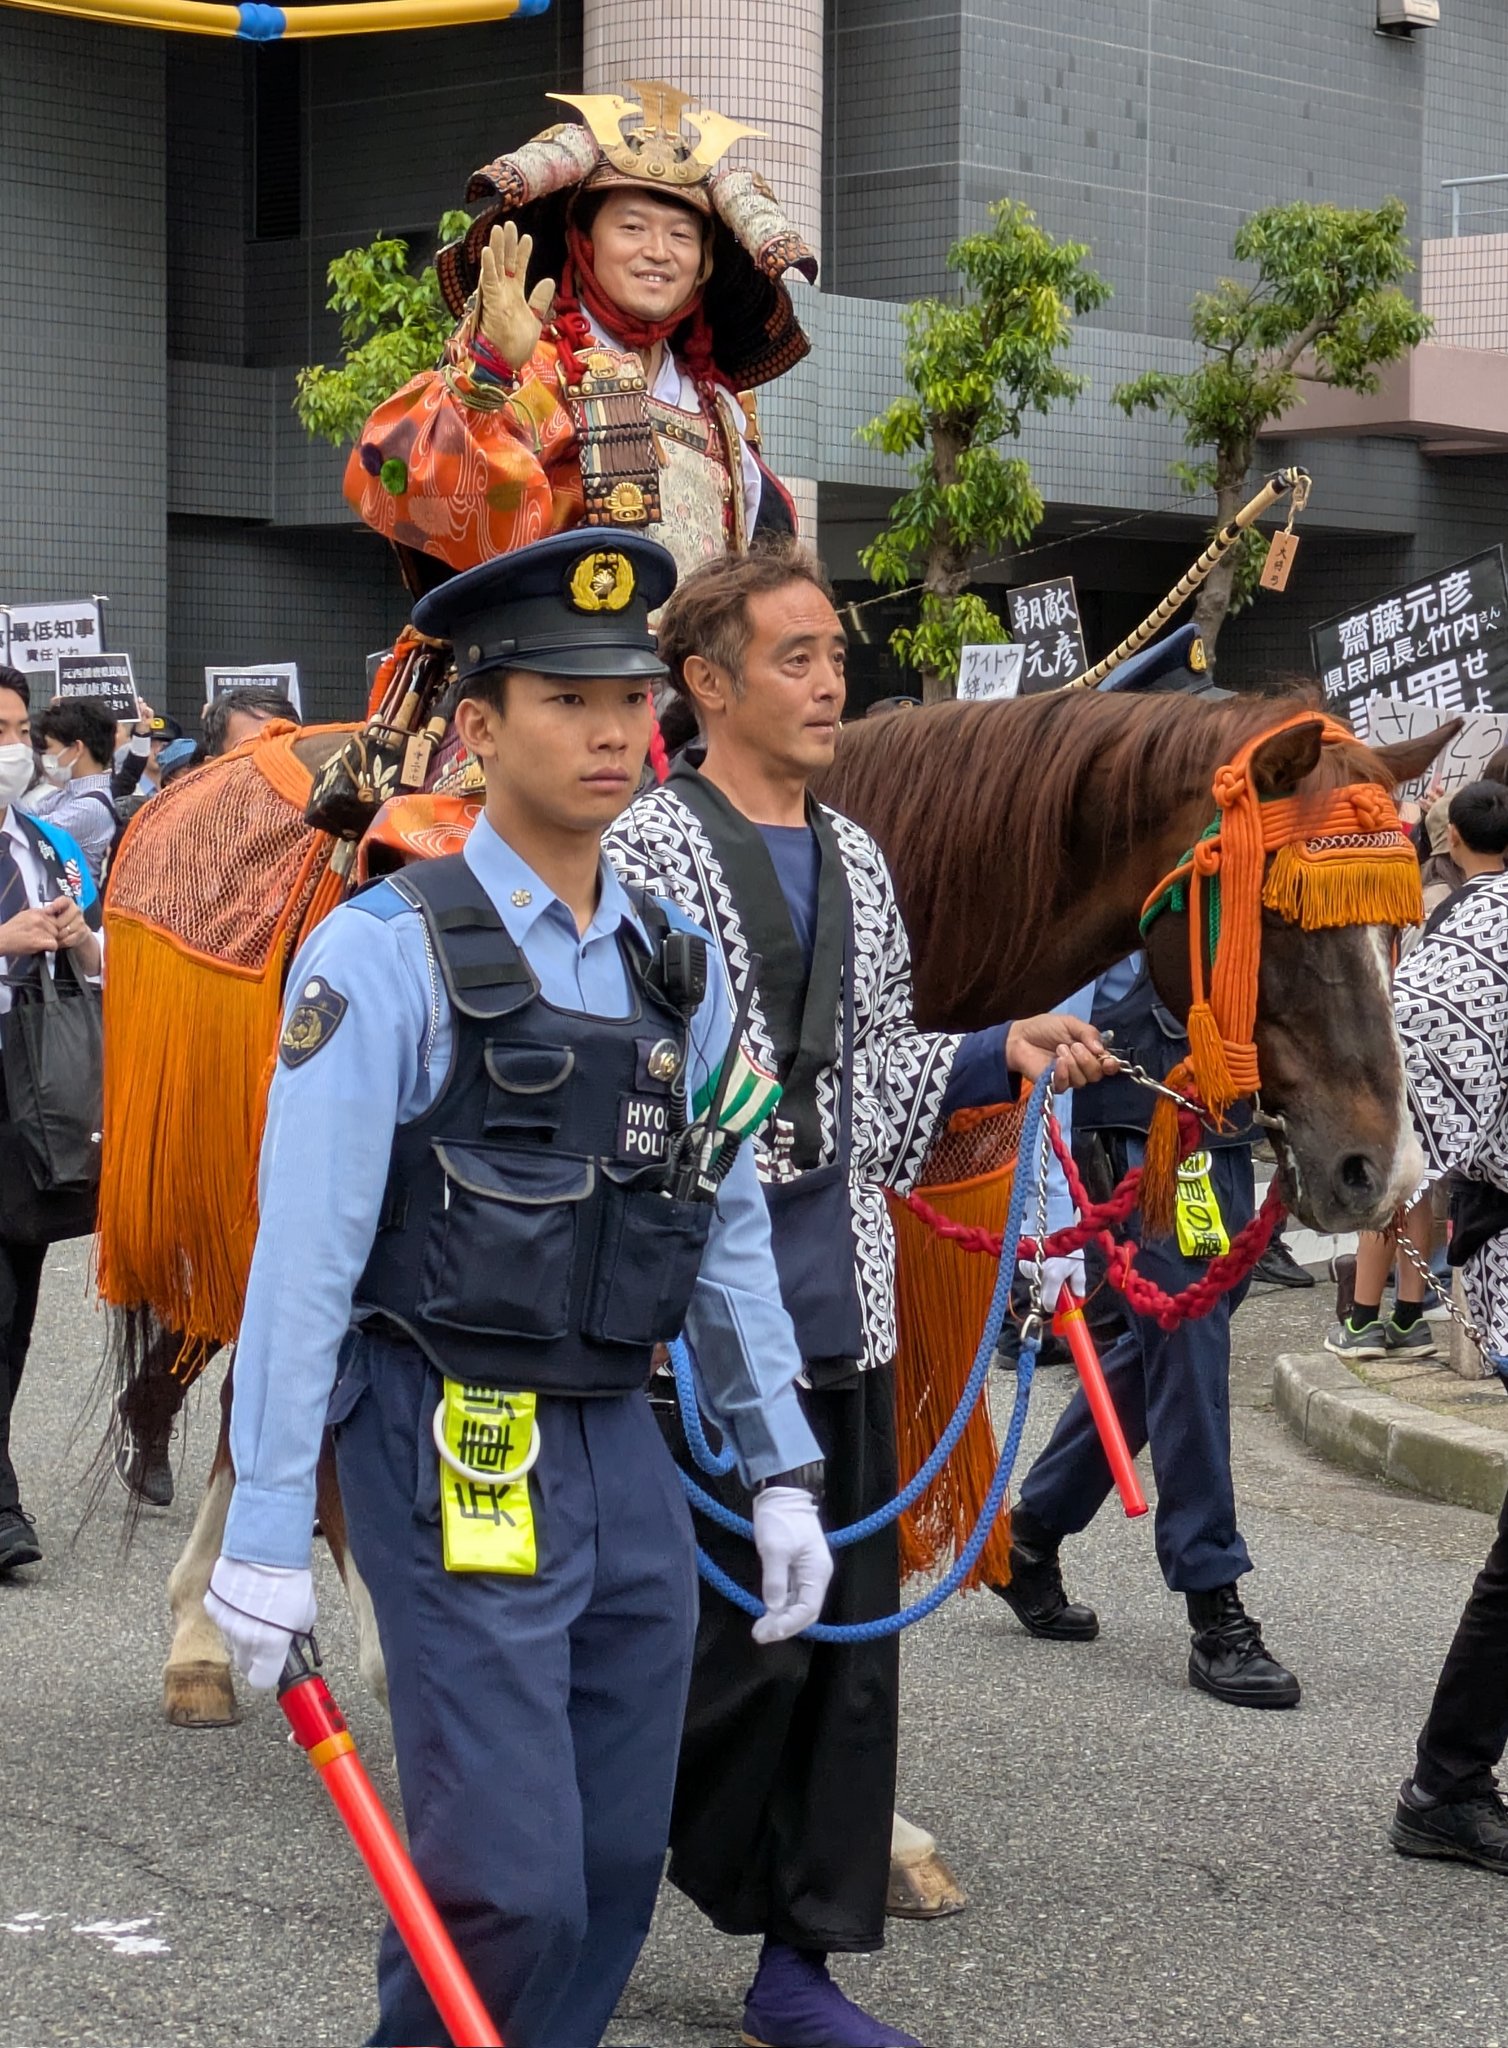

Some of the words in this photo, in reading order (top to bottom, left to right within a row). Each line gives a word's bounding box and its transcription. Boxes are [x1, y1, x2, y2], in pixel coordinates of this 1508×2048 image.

[1014, 588, 1077, 634] 朝敵
[11, 618, 95, 642] 最低知事
[966, 649, 1019, 675] サイトウ
[1025, 631, 1079, 678] 元彦
[627, 1101, 669, 1131] HYO
[625, 1129, 665, 1158] POLI
